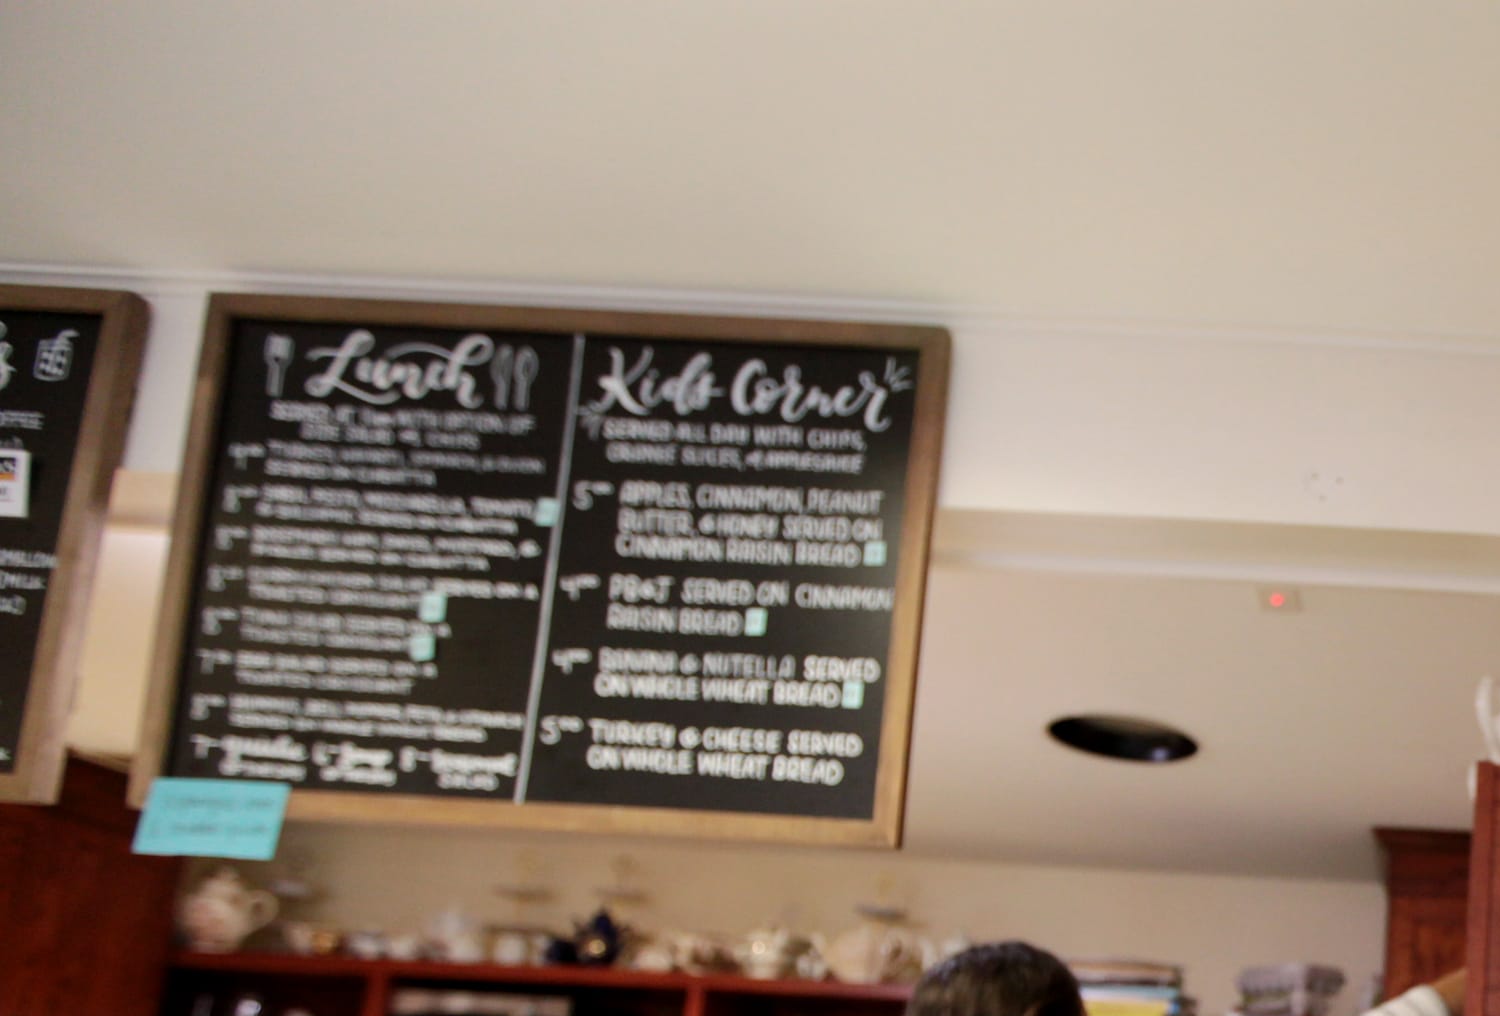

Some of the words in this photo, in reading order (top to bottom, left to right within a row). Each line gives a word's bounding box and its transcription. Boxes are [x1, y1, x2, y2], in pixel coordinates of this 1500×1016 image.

[305, 328, 494, 409] Lunch
[582, 345, 724, 416] Kids
[730, 358, 892, 432] Corner
[603, 415, 674, 442] SERVED
[754, 424, 804, 448] WITH
[807, 487, 884, 514] PEANUT
[716, 511, 781, 540] HONEY
[782, 514, 849, 543] SERVED
[850, 517, 883, 542] ON
[615, 532, 723, 561] CINNAMON
[725, 538, 792, 566] RAISIN
[794, 540, 862, 568] BREAD
[682, 576, 755, 606] SERVED
[756, 579, 789, 607] ON
[795, 582, 895, 612] CINNAMON
[606, 603, 677, 633] RAISIN
[678, 608, 744, 637] BREAD
[598, 646, 678, 675] BANANA
[701, 652, 797, 680] NUTELLA
[803, 654, 882, 684] SERVED
[594, 672, 631, 699] ON
[631, 675, 701, 702] WHOLE
[701, 677, 773, 705] WHEAT
[772, 680, 841, 708] BREAD
[587, 717, 677, 746] TURKEY
[701, 726, 783, 753] CHEESE
[787, 728, 864, 758] SERVED
[586, 744, 622, 770] ON
[622, 747, 694, 776] WHOLE
[697, 751, 771, 781] WHEAT
[771, 755, 844, 787] BREAD
